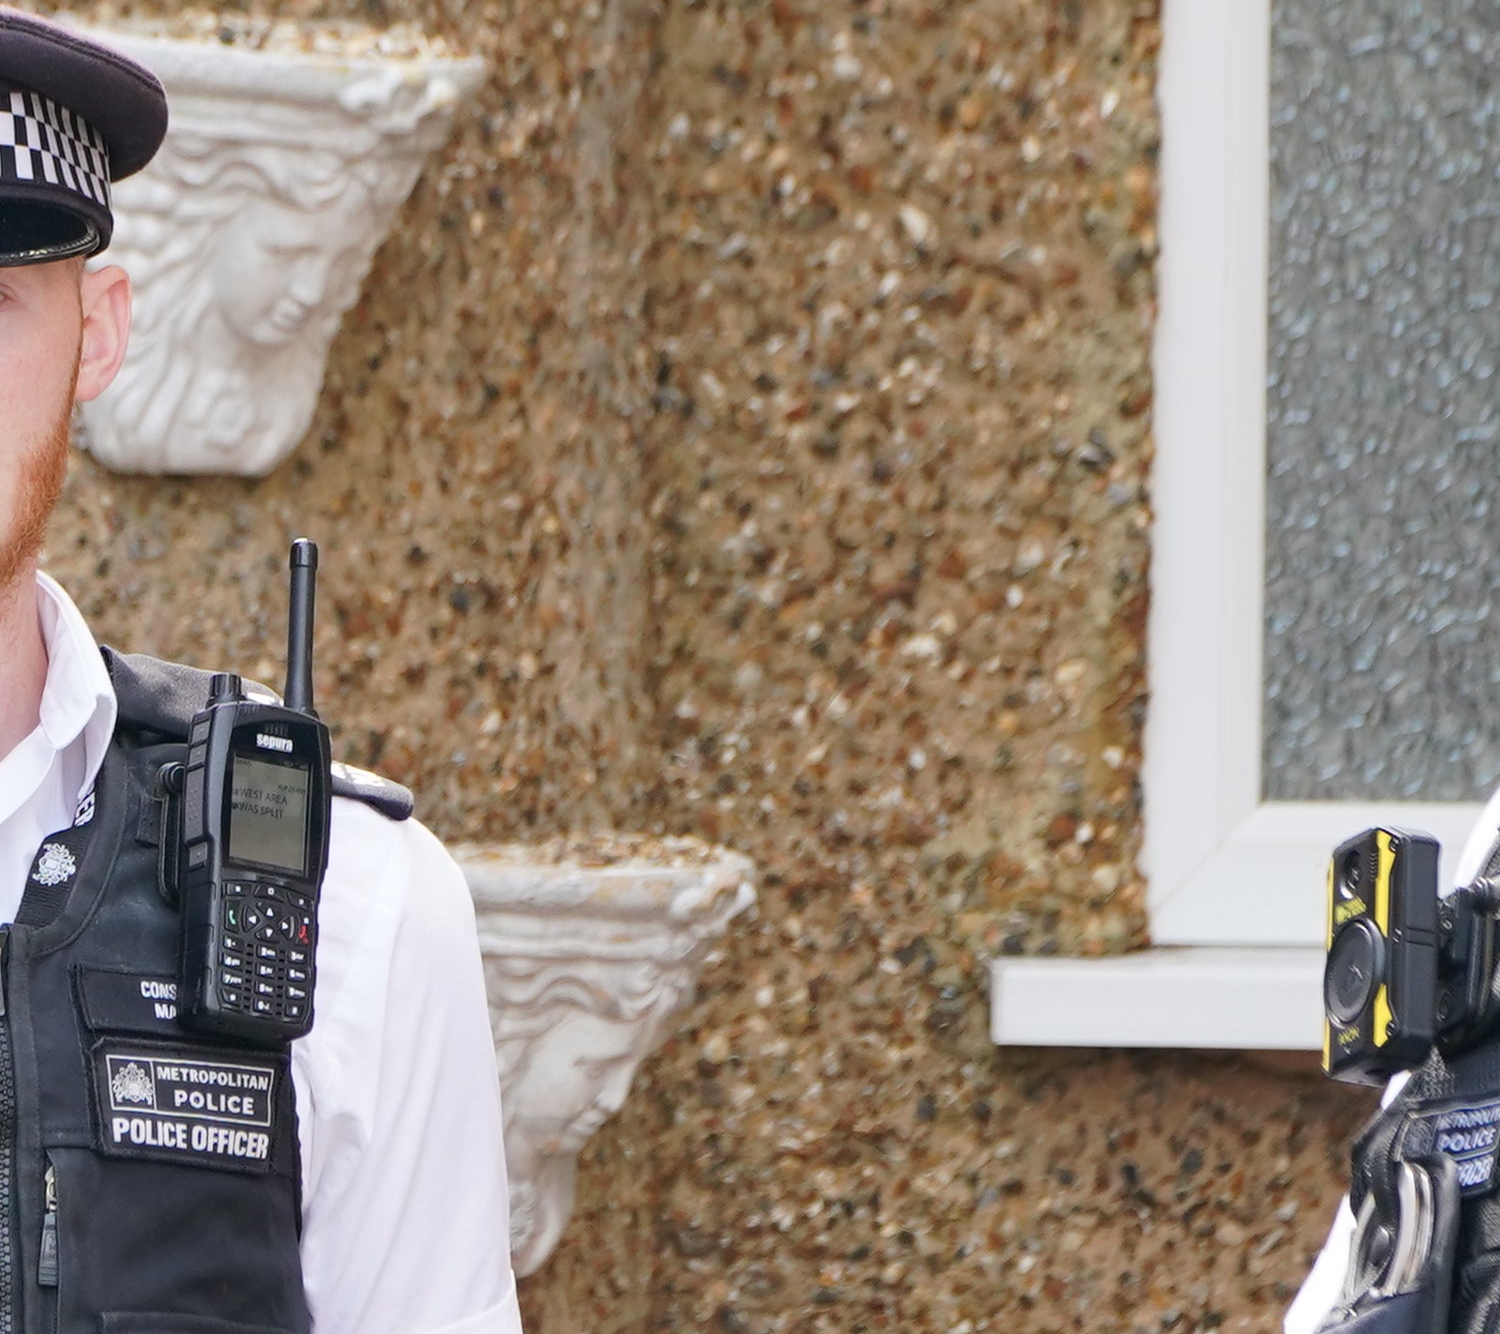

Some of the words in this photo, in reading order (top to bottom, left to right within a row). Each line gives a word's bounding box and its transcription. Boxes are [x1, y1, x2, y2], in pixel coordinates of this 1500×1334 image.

[256, 733, 294, 753] sepura
[157, 1066, 268, 1091] METROPOLITAN
[174, 1089, 254, 1116] POLICE
[112, 1118, 187, 1149] POLICE
[191, 1125, 269, 1159] OFFICER
[1439, 1127, 1496, 1152] POLICE
